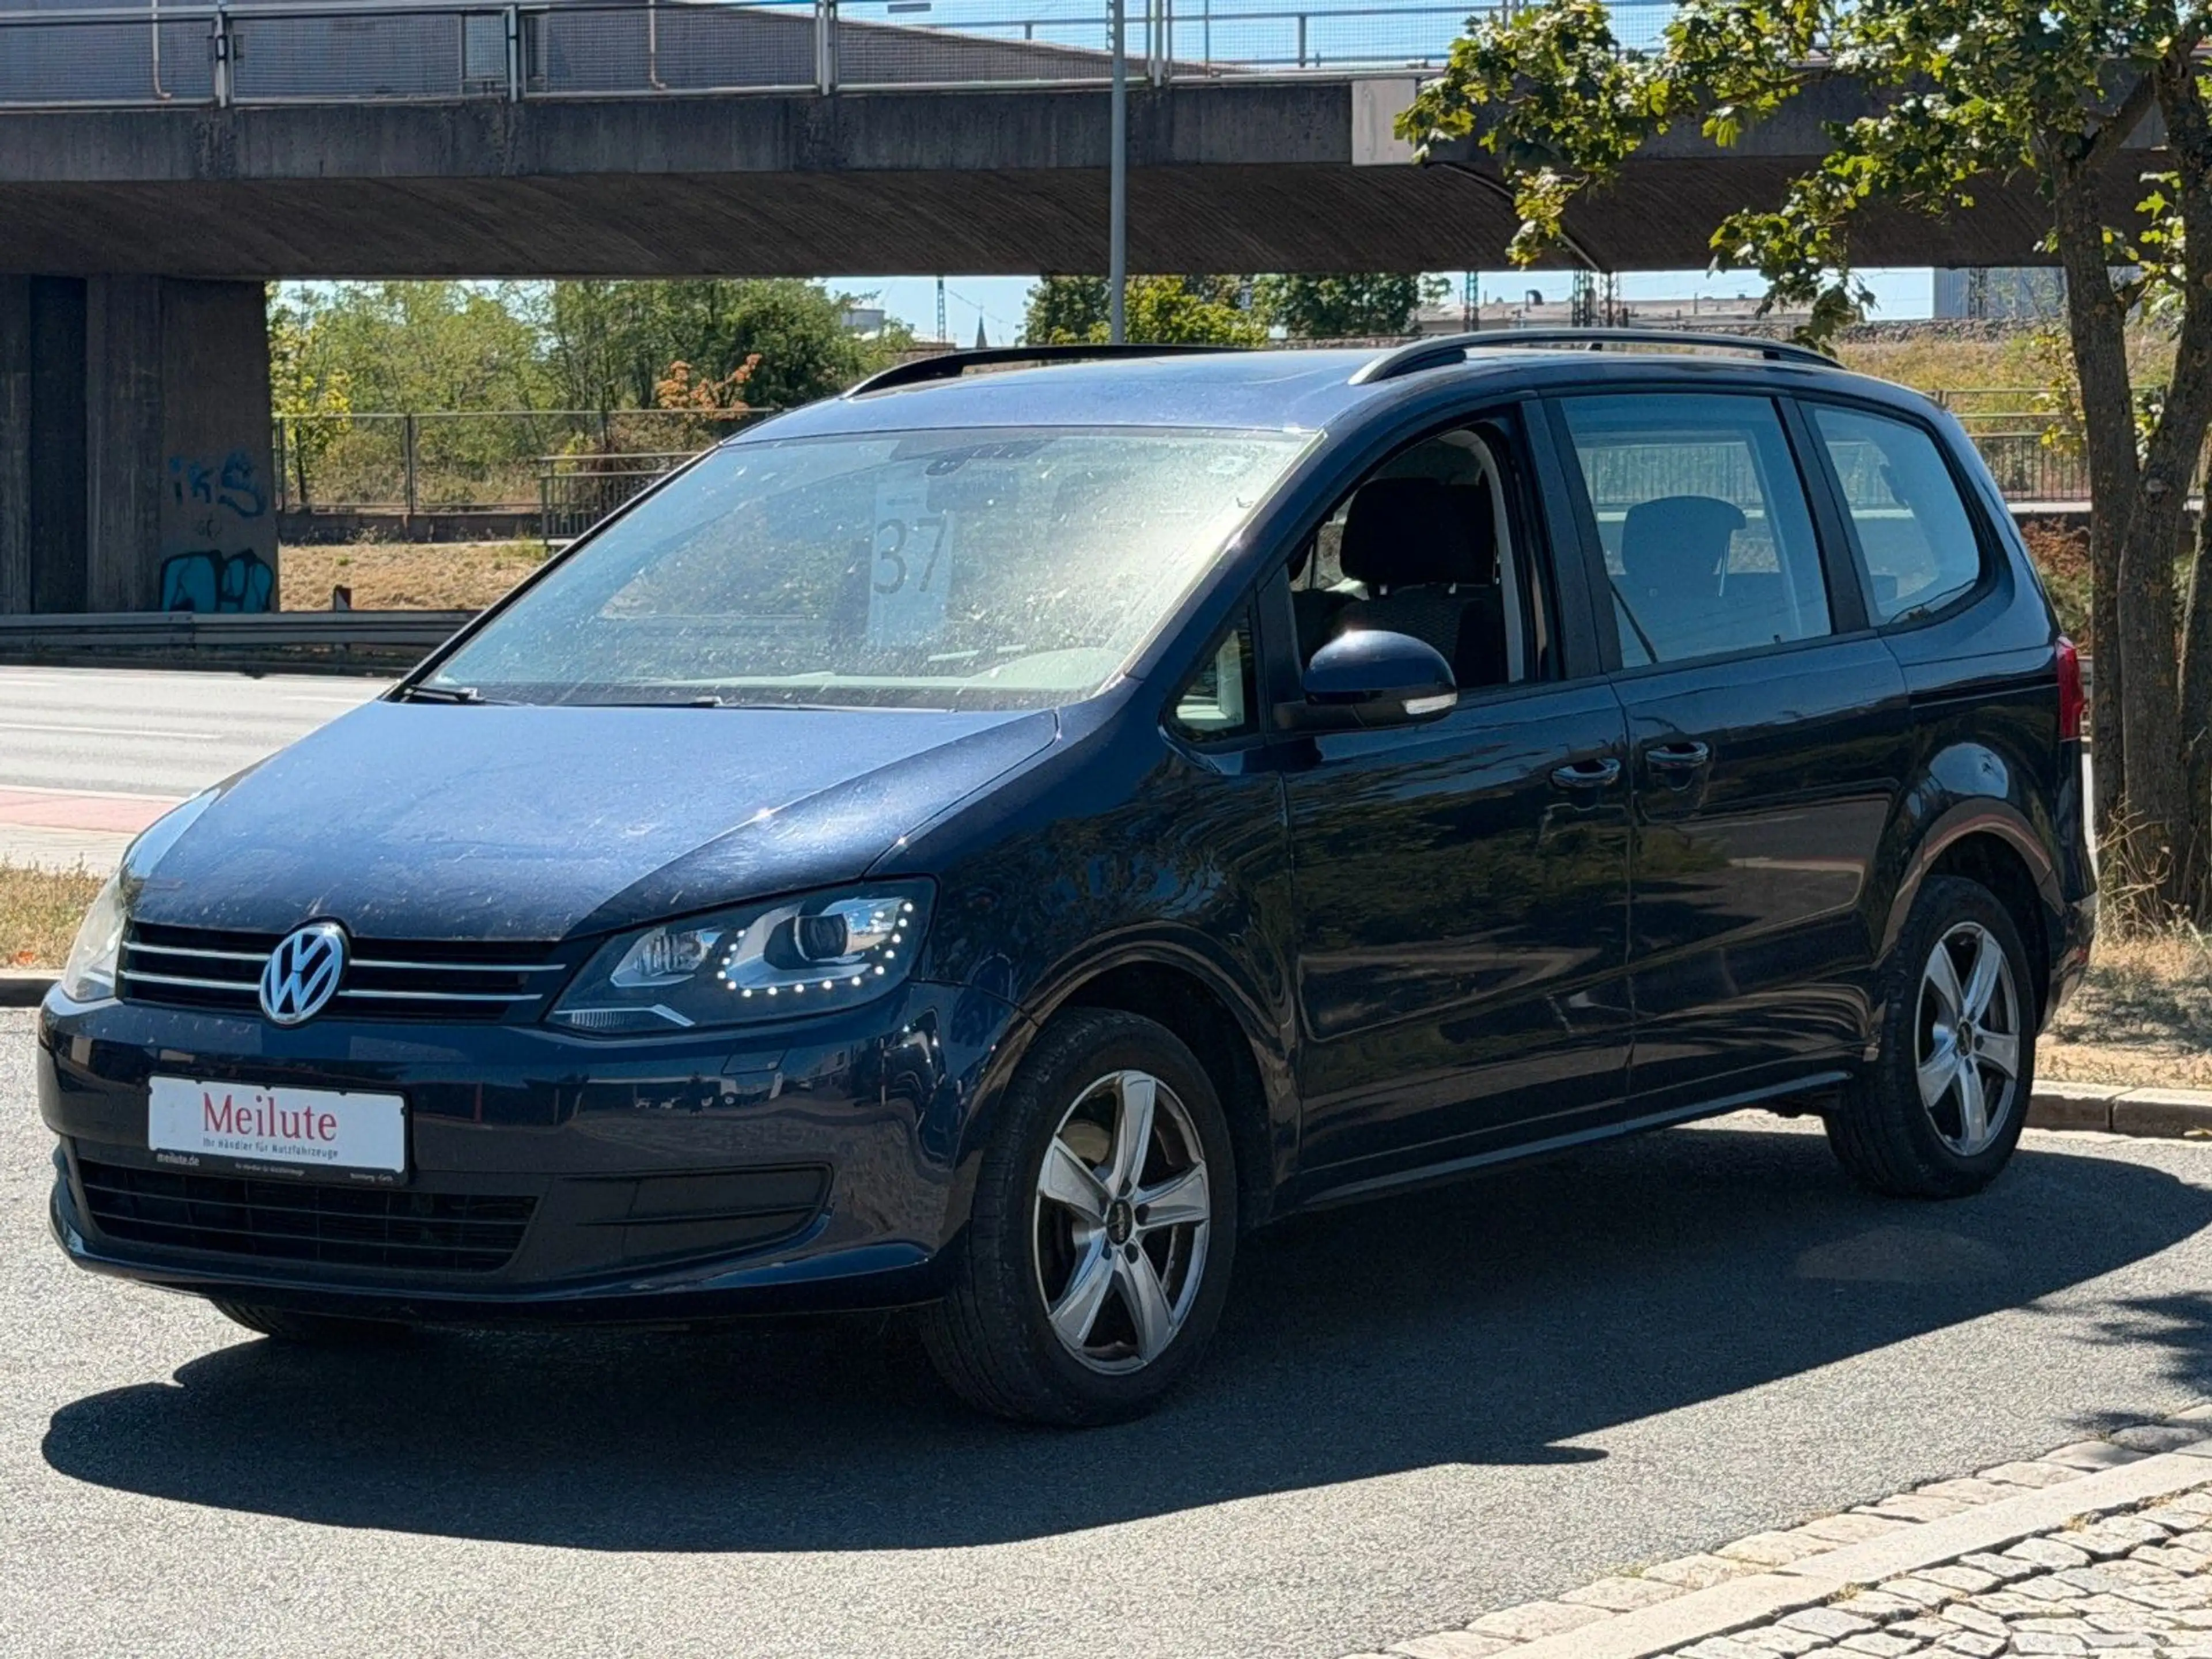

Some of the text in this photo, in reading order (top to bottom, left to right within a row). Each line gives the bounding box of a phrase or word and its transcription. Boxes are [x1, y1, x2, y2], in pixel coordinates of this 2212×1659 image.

[873, 516, 948, 594] 37
[203, 1092, 338, 1141] Meilute
[203, 1137, 339, 1160] Ihr Händler für Nutzfahrzeuge
